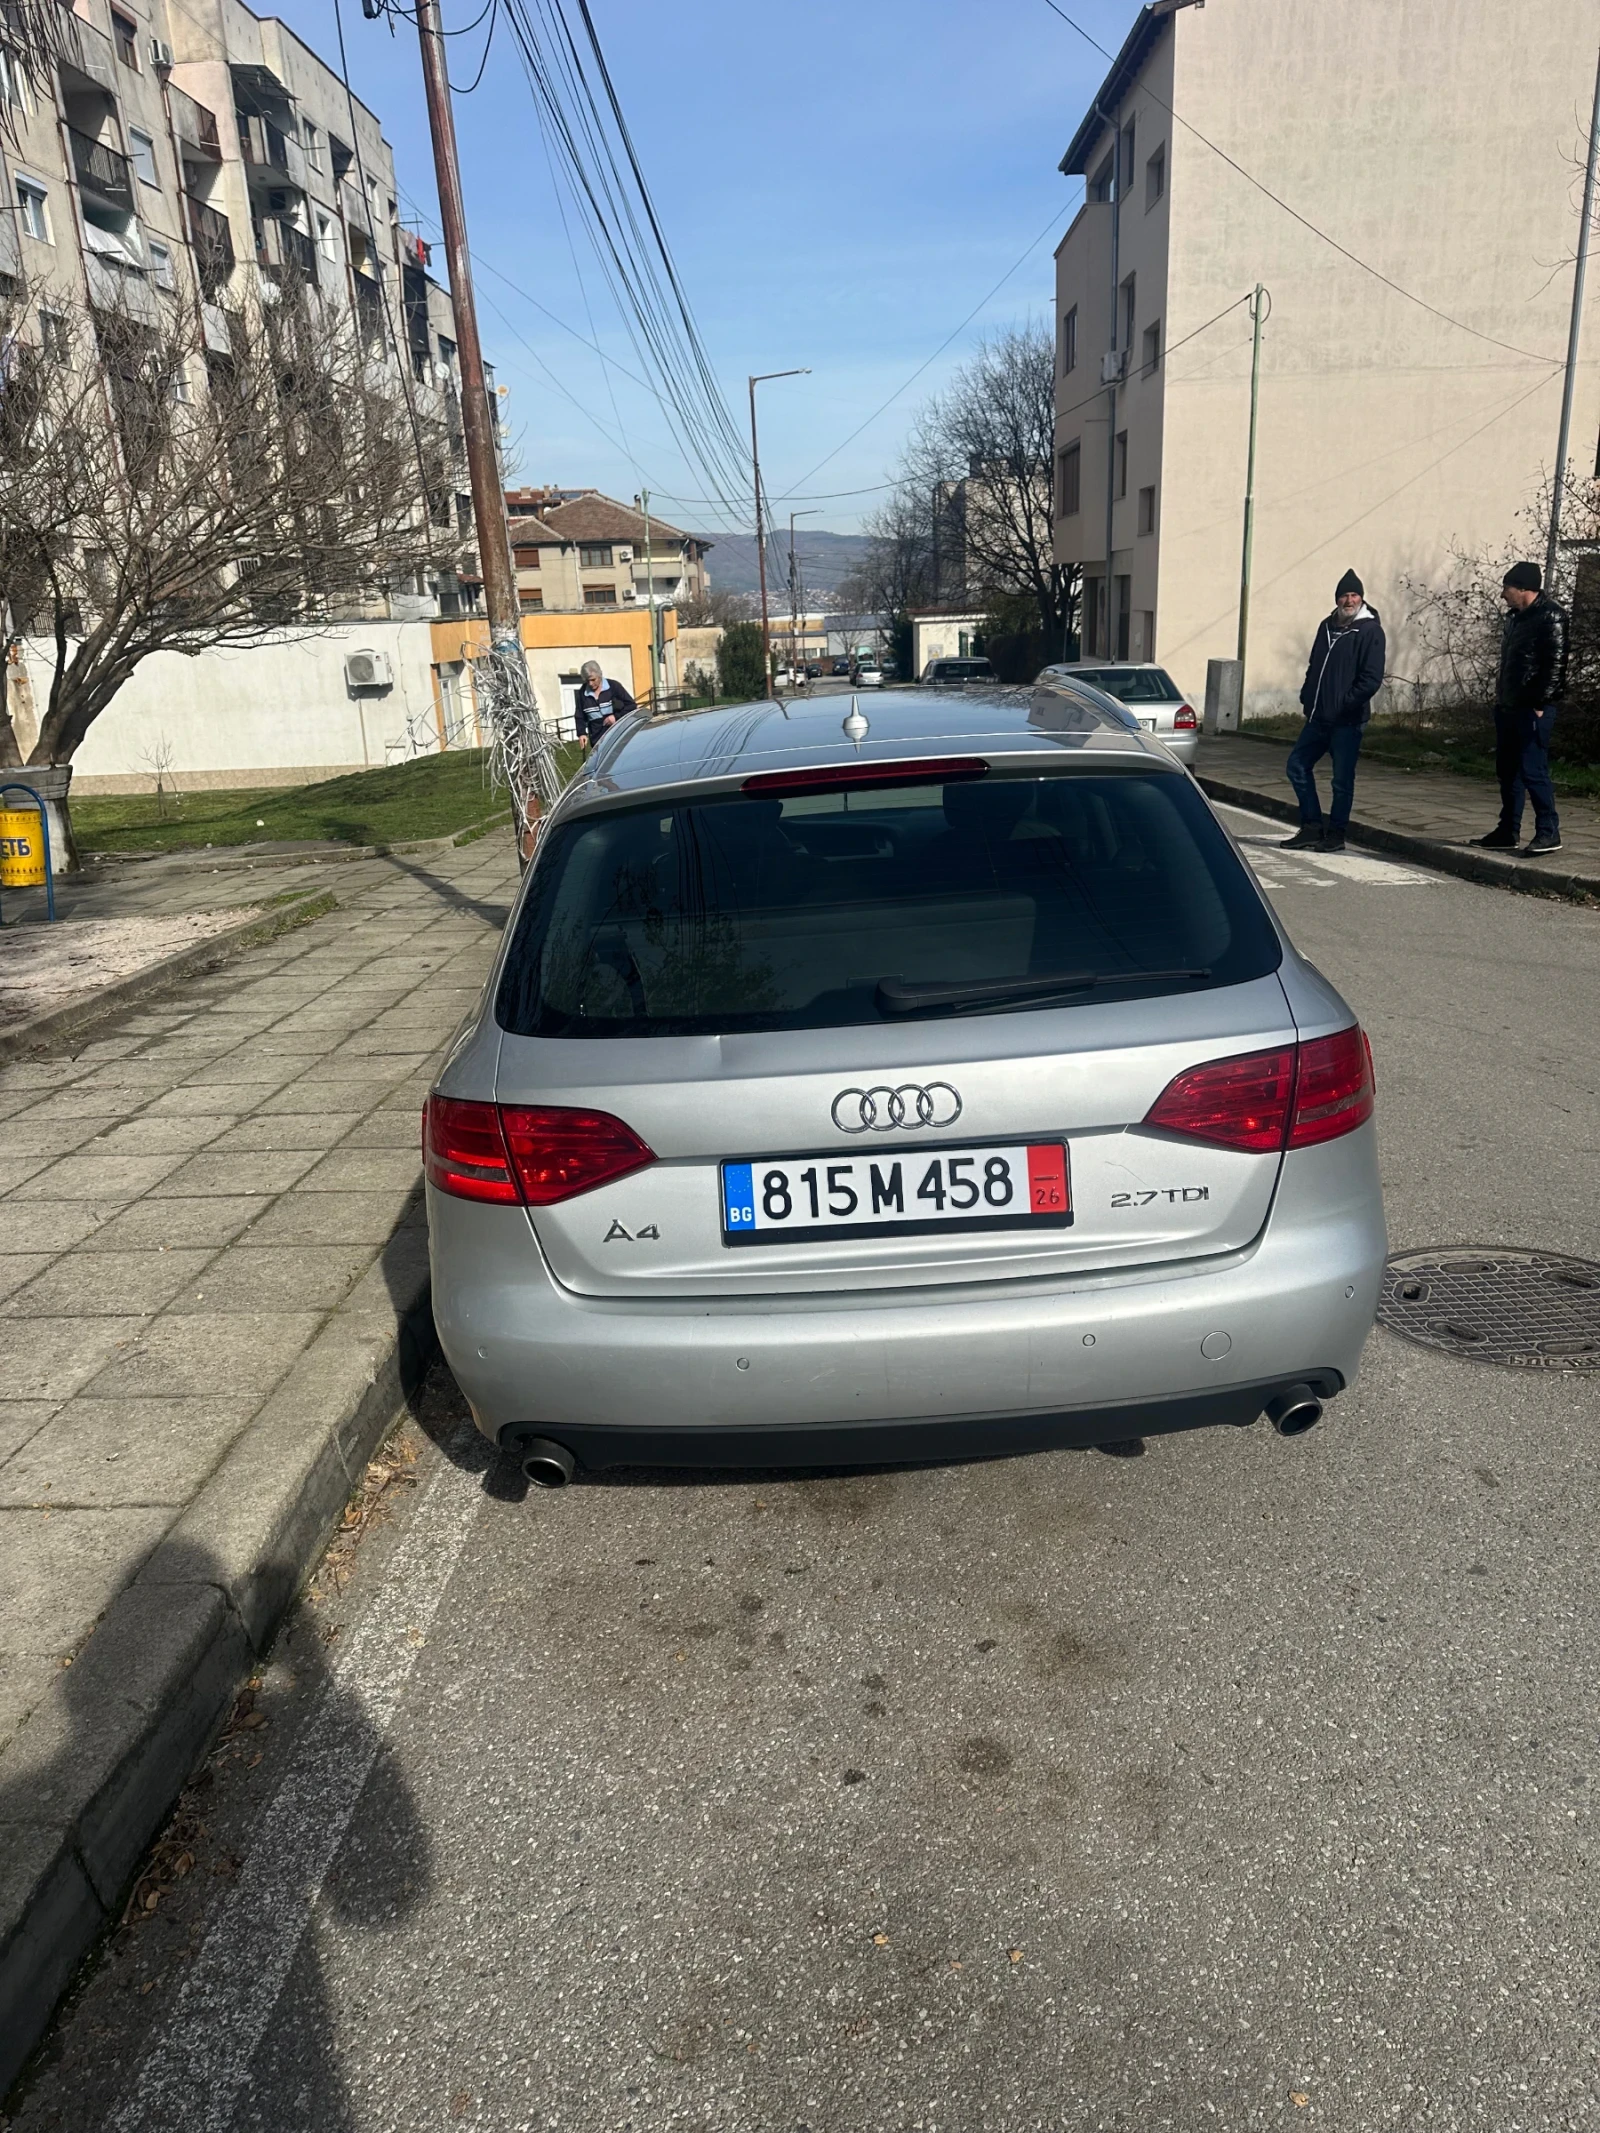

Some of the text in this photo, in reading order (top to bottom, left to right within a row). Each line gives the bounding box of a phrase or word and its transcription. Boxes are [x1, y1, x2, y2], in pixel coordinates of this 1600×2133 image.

[1035, 1187, 1060, 1205] 26
[1111, 1186, 1210, 1208] 2.7 TDI
[730, 1206, 752, 1223] BG
[602, 1218, 660, 1243] A4
